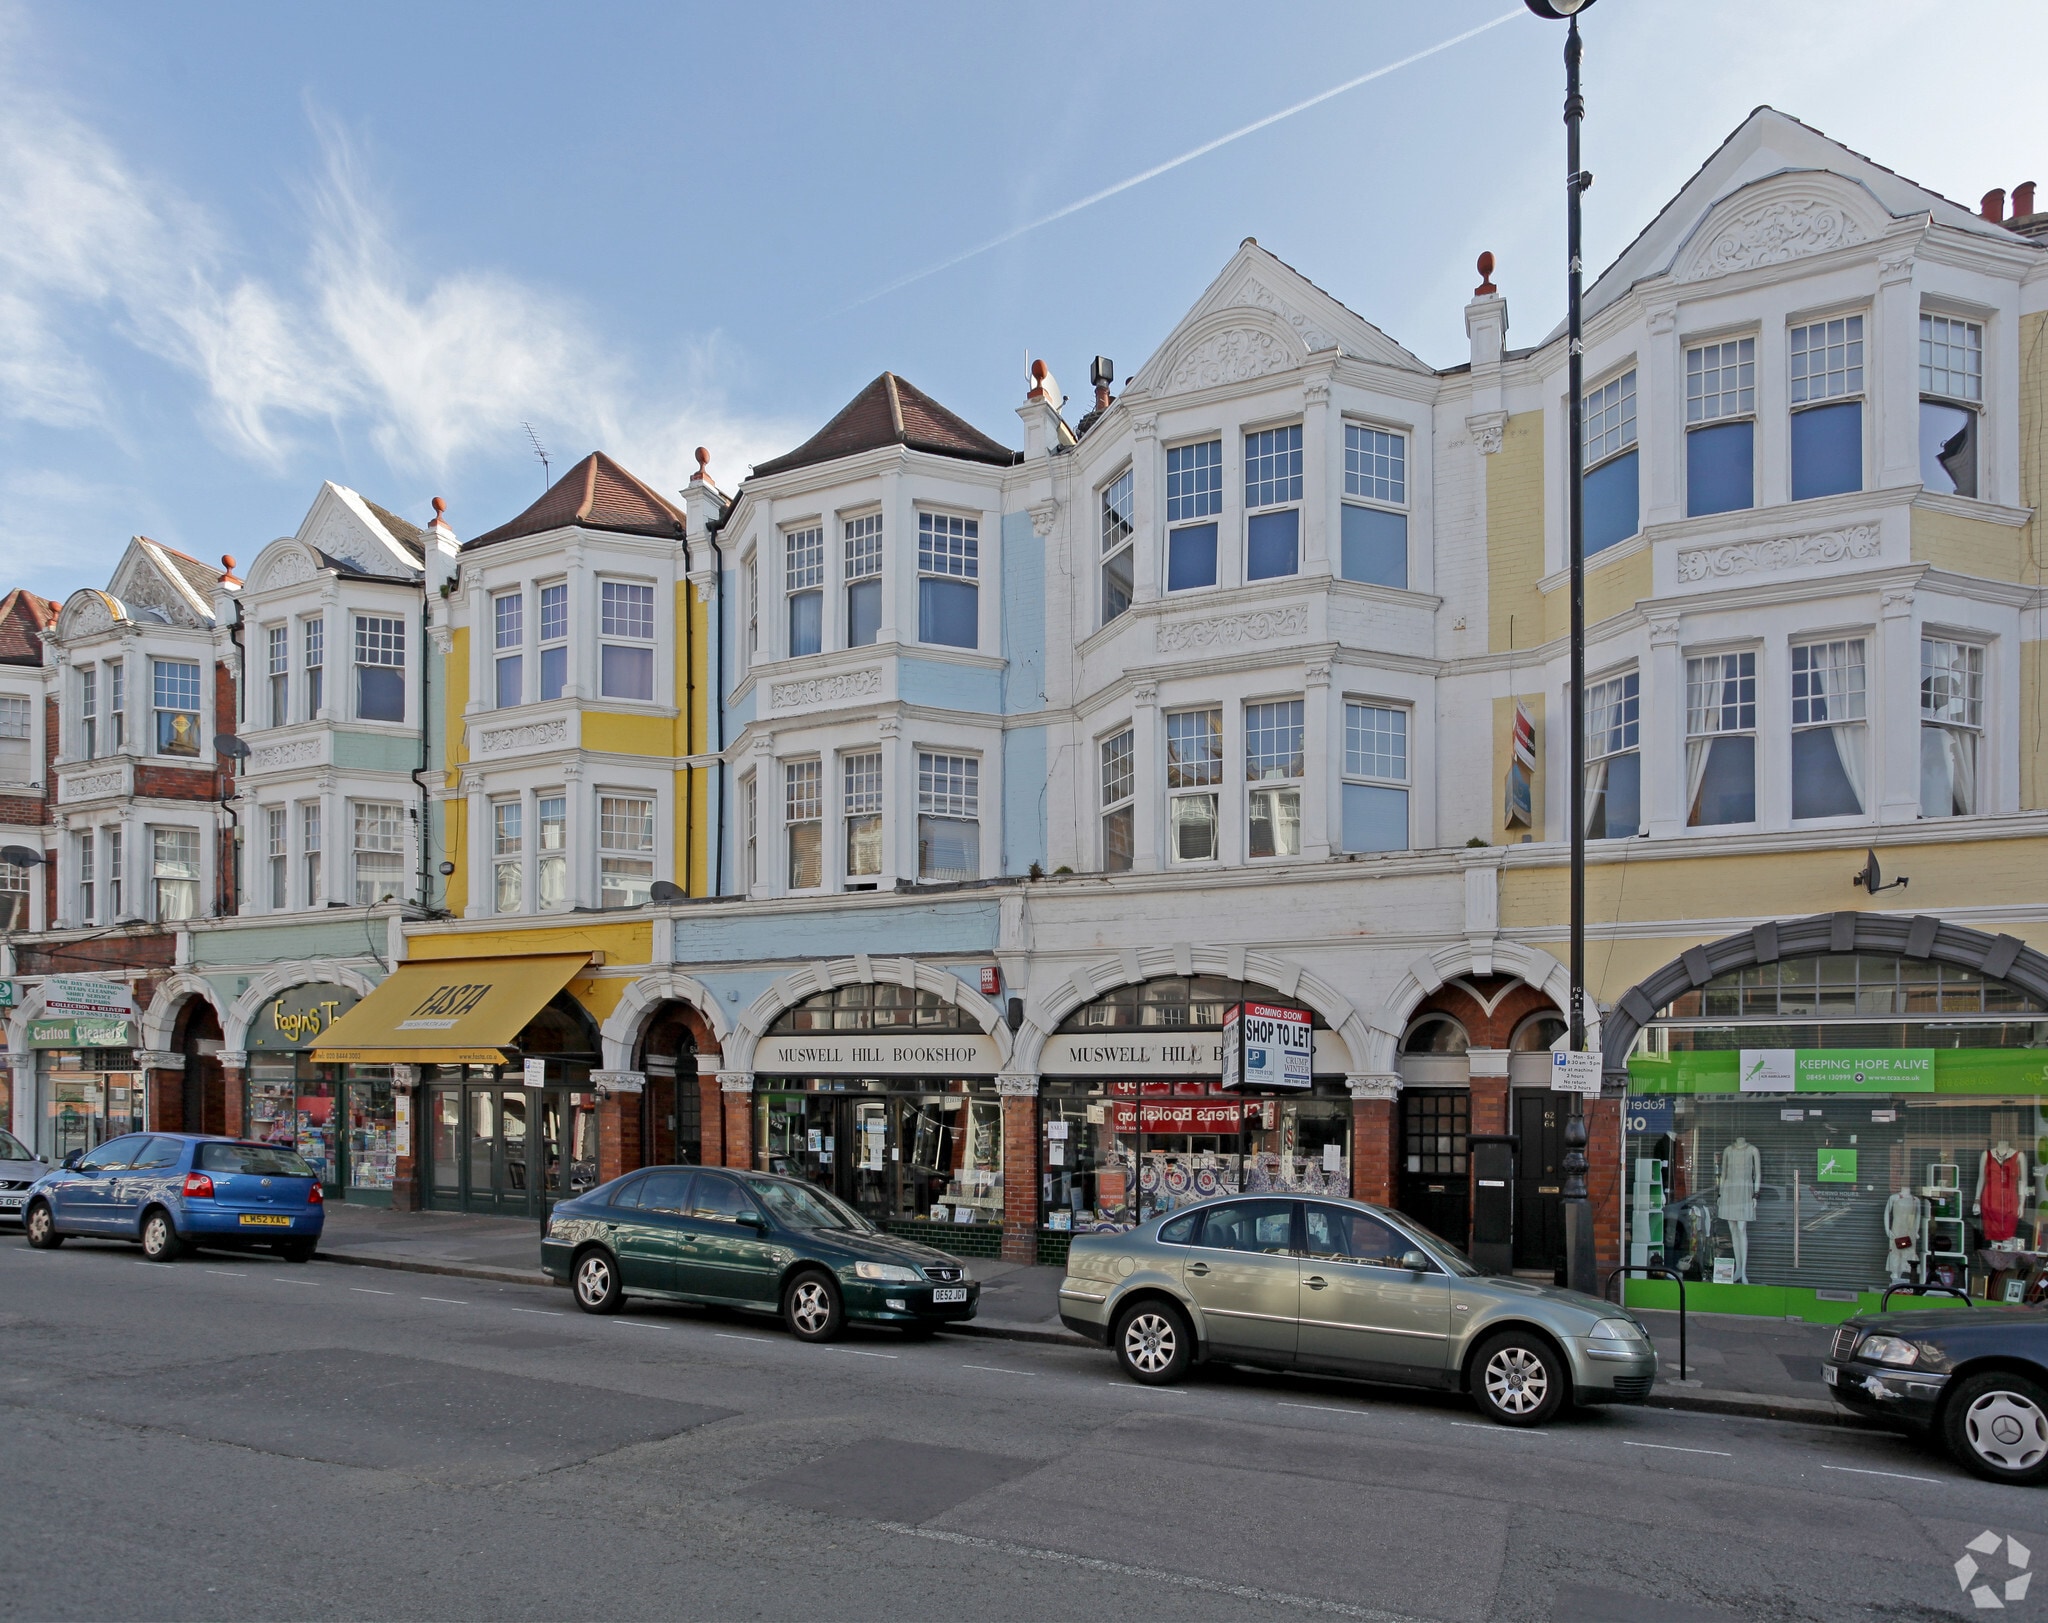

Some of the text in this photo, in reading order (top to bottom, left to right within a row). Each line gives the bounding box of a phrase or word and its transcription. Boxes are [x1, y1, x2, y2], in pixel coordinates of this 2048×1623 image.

[85, 982, 124, 991] ALTERATIONS
[51, 1001, 90, 1010] COLLECTION
[410, 984, 493, 1016] FASTA
[1255, 1006, 1302, 1020] COMING SOON
[274, 1000, 321, 1041] Fagins
[33, 1026, 121, 1040] Carlton Cleaners
[1246, 1019, 1274, 1043] SHOP
[1277, 1023, 1289, 1045] TO
[1293, 1026, 1309, 1048] LET
[778, 1047, 976, 1062] MUSWELL HILL BOOKSHOP
[1070, 1047, 1150, 1062] MUSWELL
[1162, 1046, 1202, 1061] HILL
[1286, 1056, 1308, 1066] CRUMP
[1284, 1064, 1309, 1074] WINTER
[1800, 1060, 1929, 1070] KEEPING HOPE ALIVE
